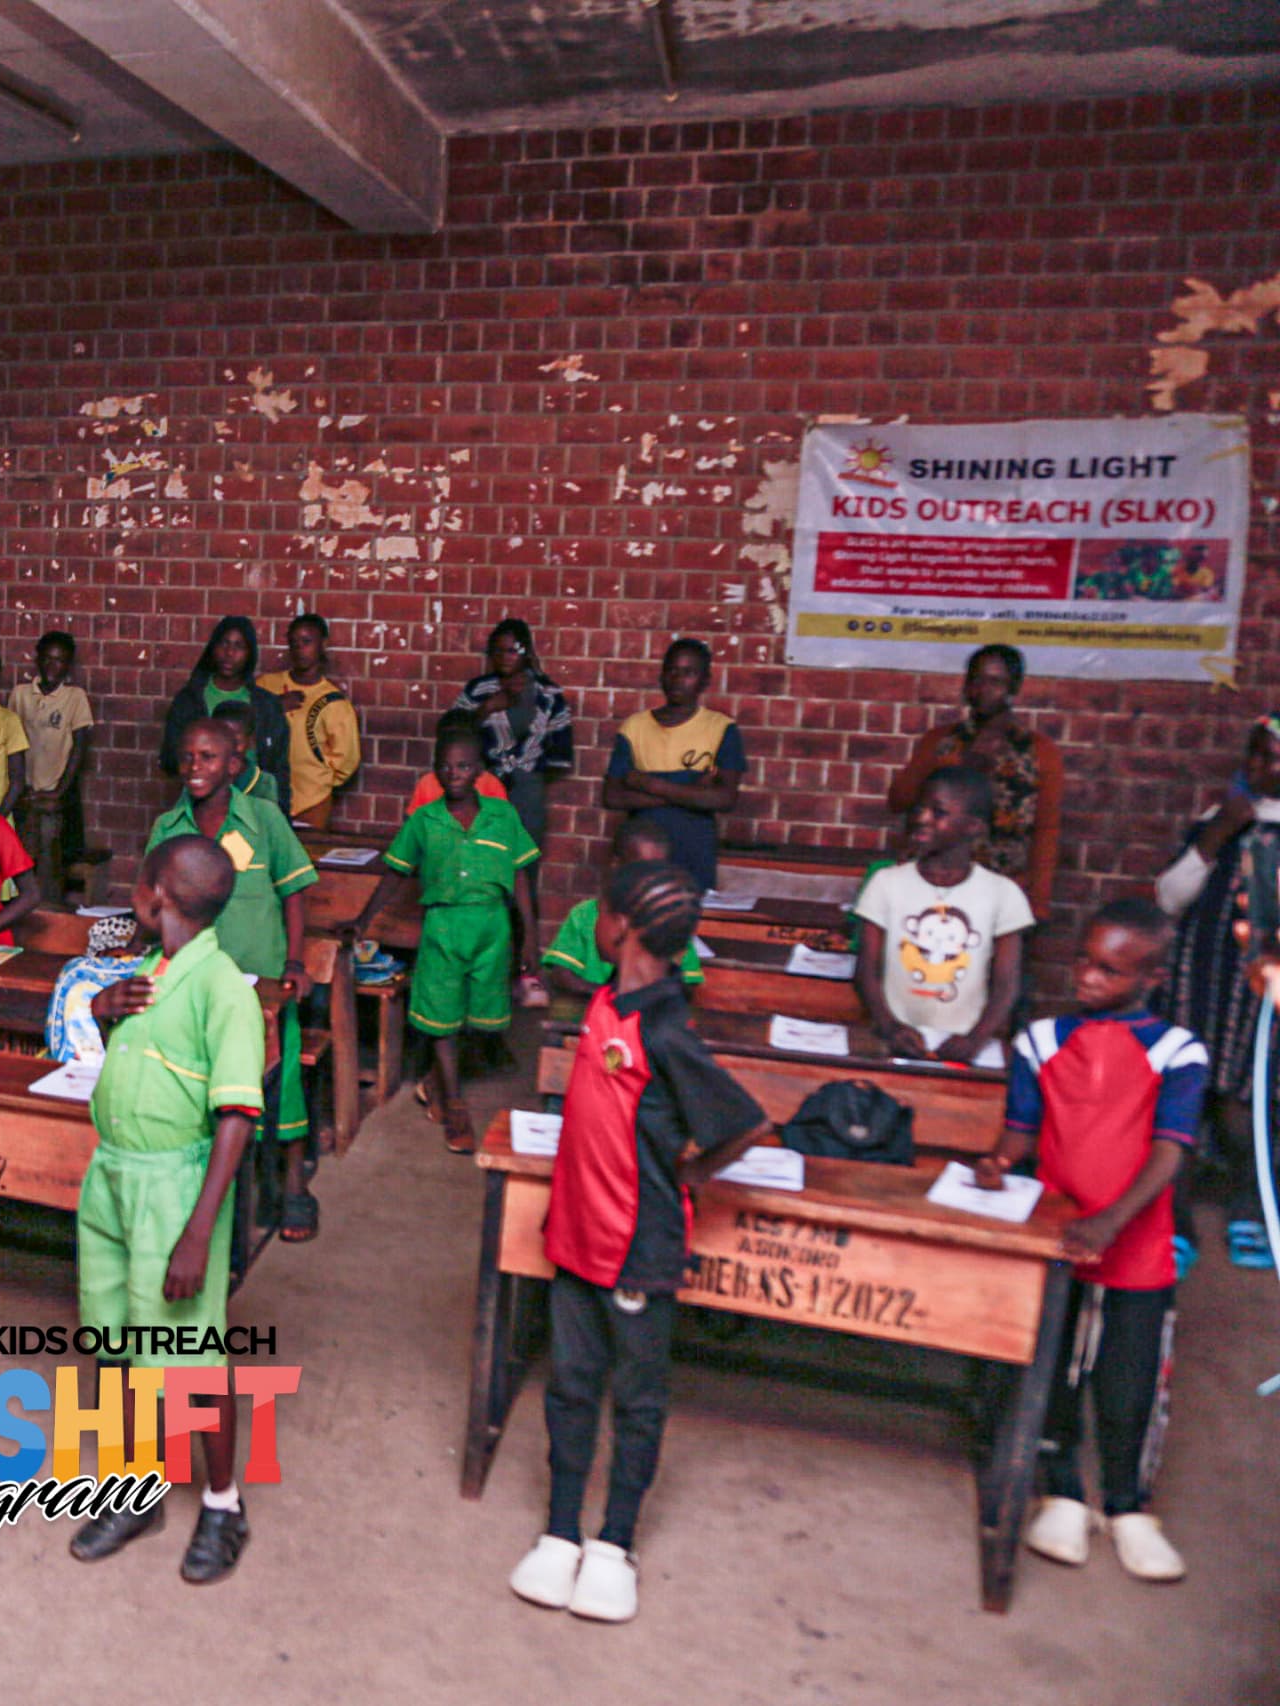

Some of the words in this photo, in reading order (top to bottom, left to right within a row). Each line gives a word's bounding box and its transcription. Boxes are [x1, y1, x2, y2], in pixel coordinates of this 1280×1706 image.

[909, 458, 1056, 480] SHINING
[1067, 456, 1177, 479] LIGHT
[832, 495, 907, 519] KIDS
[917, 498, 1091, 523] OUTREACH
[1100, 498, 1216, 528] (SLKO)
